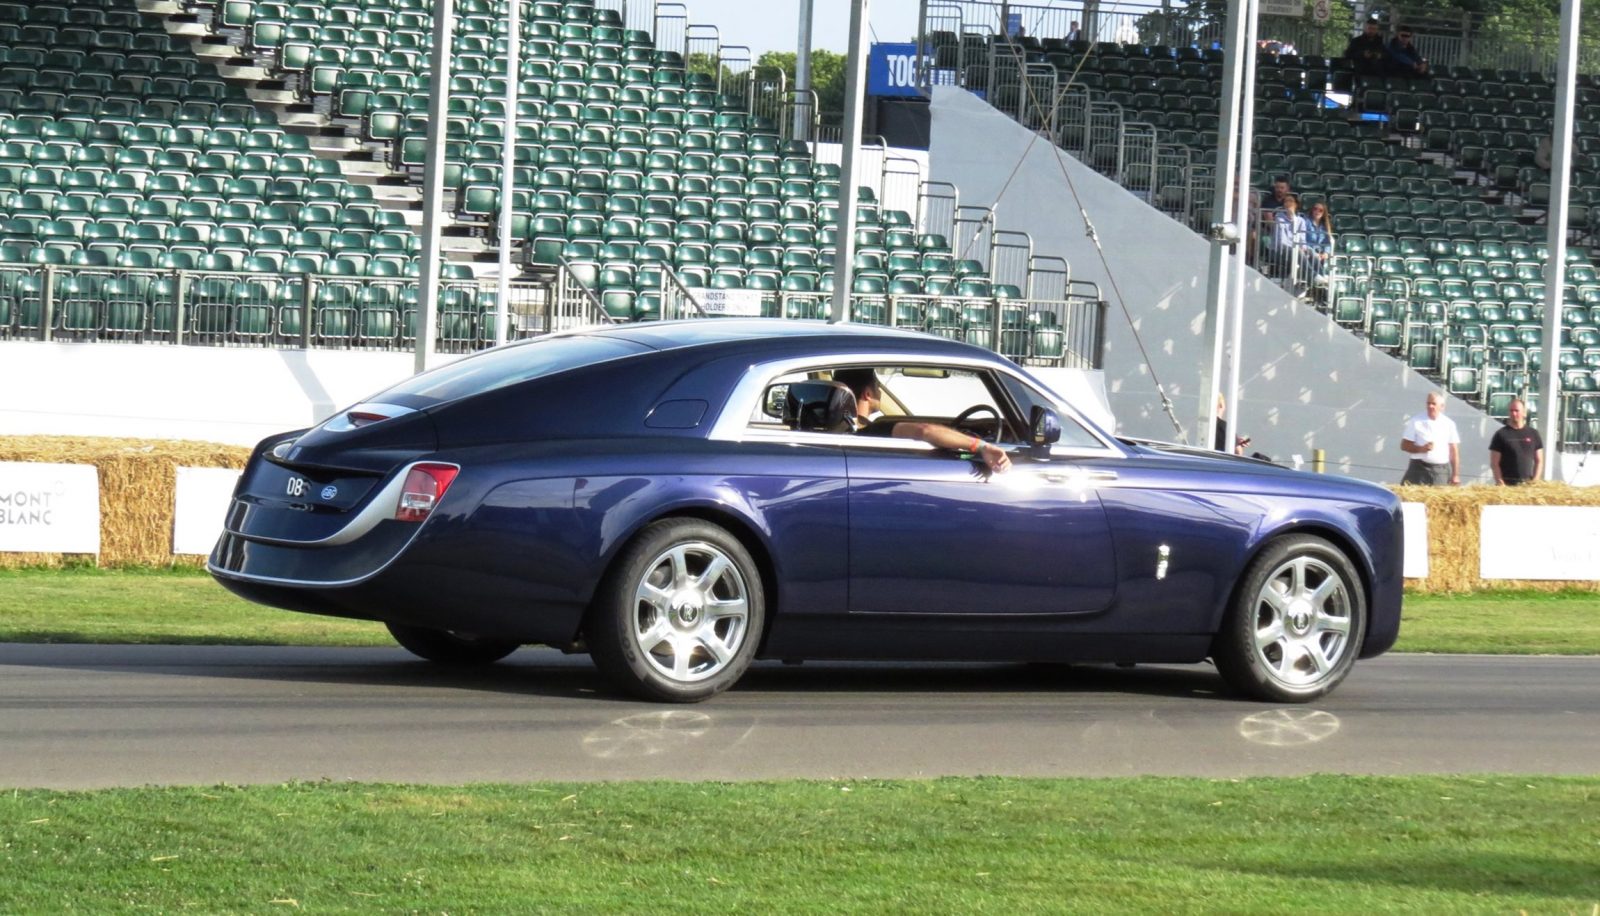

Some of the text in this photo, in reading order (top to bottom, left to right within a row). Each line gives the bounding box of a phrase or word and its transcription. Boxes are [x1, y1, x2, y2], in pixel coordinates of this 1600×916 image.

[286, 476, 304, 497] 08
[0, 491, 52, 507] MONT
[0, 508, 52, 525] BLANC
